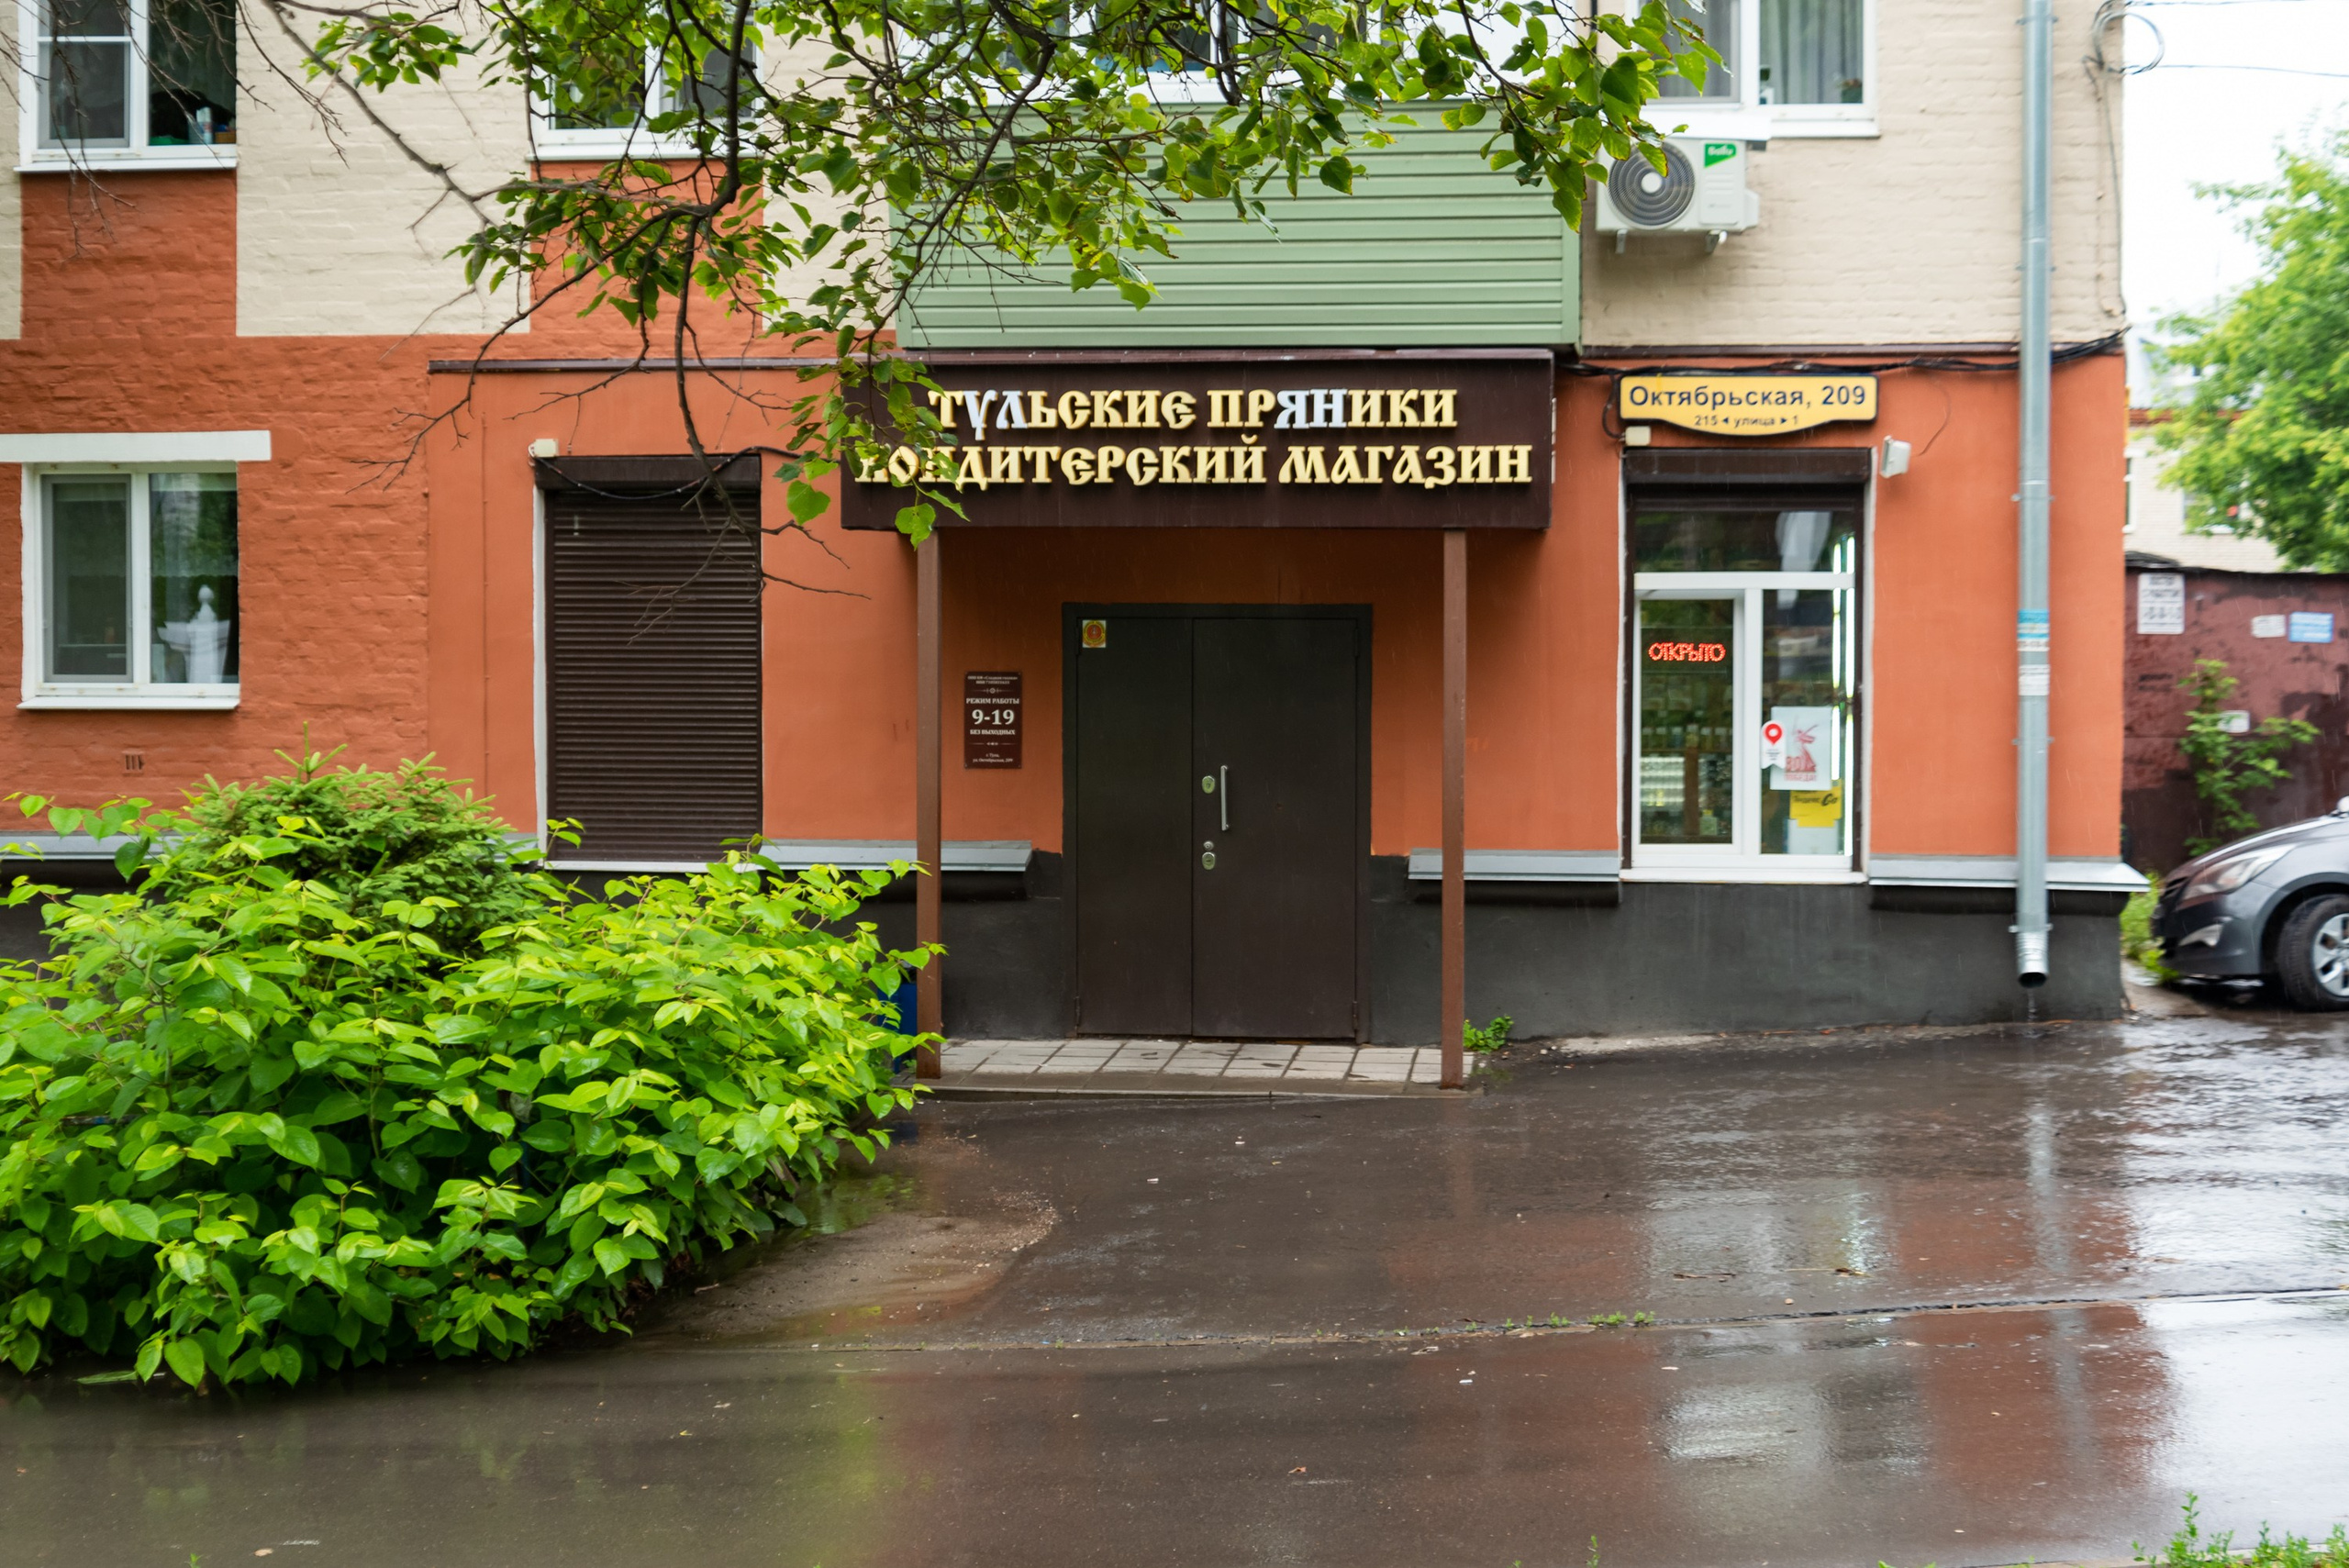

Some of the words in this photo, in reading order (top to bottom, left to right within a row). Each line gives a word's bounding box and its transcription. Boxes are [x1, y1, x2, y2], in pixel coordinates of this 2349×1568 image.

[1630, 385, 1810, 410] Октябрьская,
[1820, 385, 1865, 406] 209
[929, 389, 1197, 440] ТУЛЬСКИЕ
[1207, 389, 1458, 429] ПРЯНИКИ
[1694, 415, 1718, 426] 215
[1734, 417, 1776, 428] улица
[1792, 414, 1798, 426] 1
[1278, 444, 1532, 489] МАГАЗИН
[1648, 642, 1726, 662] ОТКРЫТО
[972, 709, 1015, 725] 9-19
